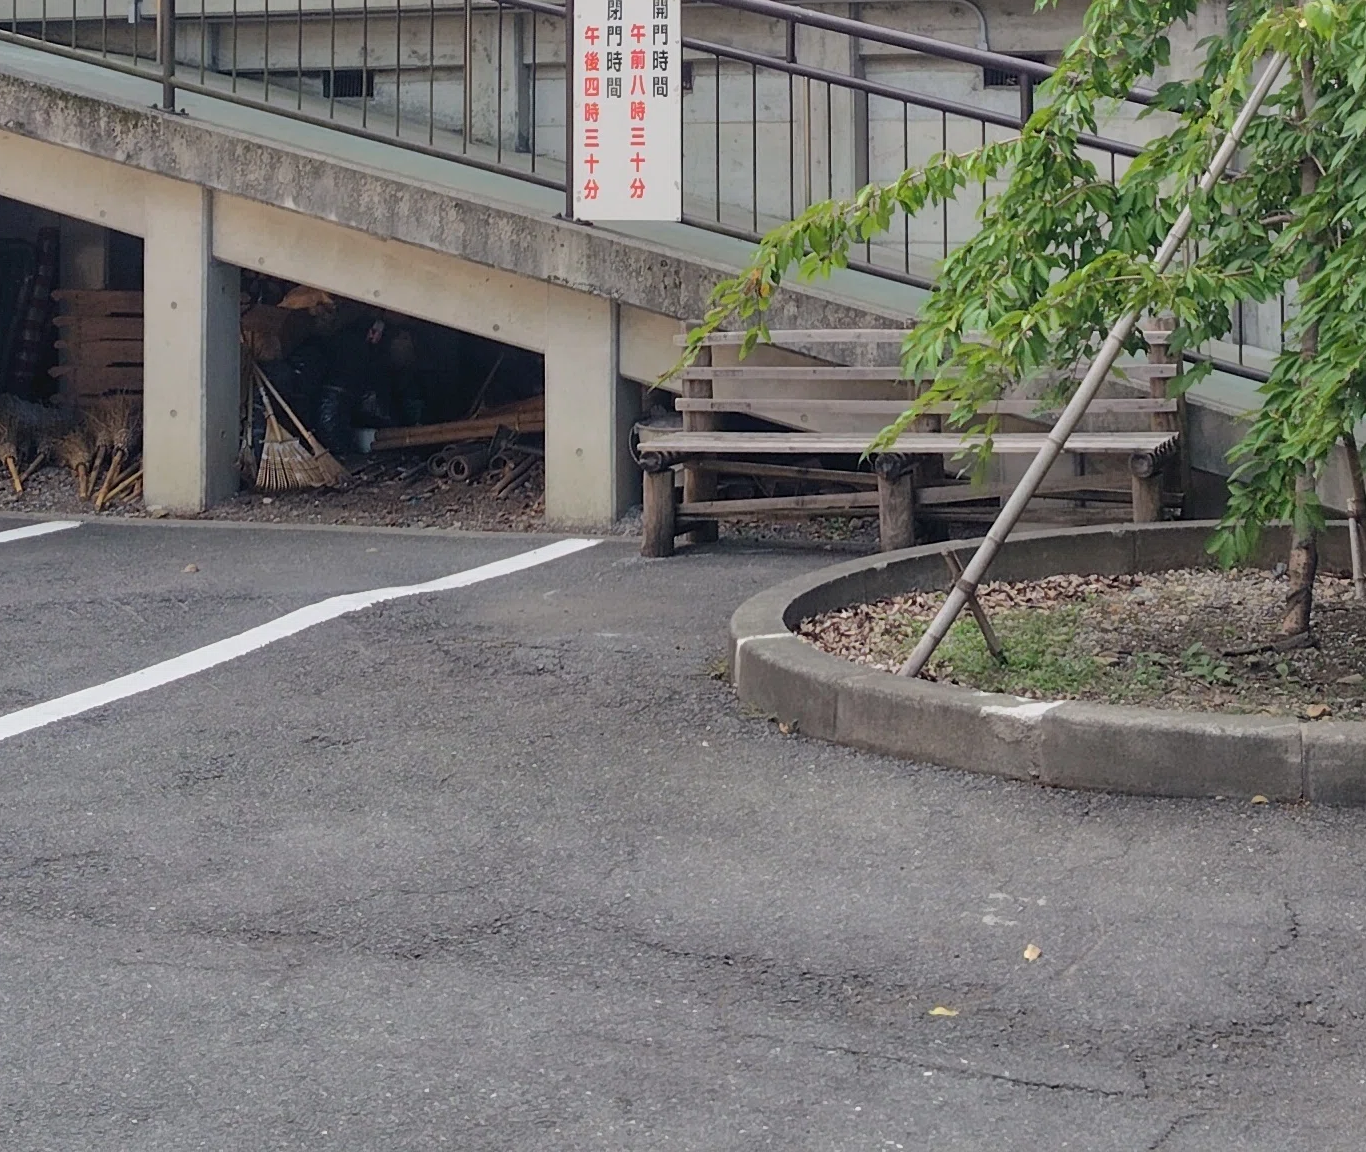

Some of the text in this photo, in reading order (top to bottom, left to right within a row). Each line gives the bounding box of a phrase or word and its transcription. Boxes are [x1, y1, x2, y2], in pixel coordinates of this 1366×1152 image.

[584, 26, 600, 199] 午後四時三十分
[606, 0, 623, 98] 閉門時間
[630, 24, 646, 199] 午前八時三十分
